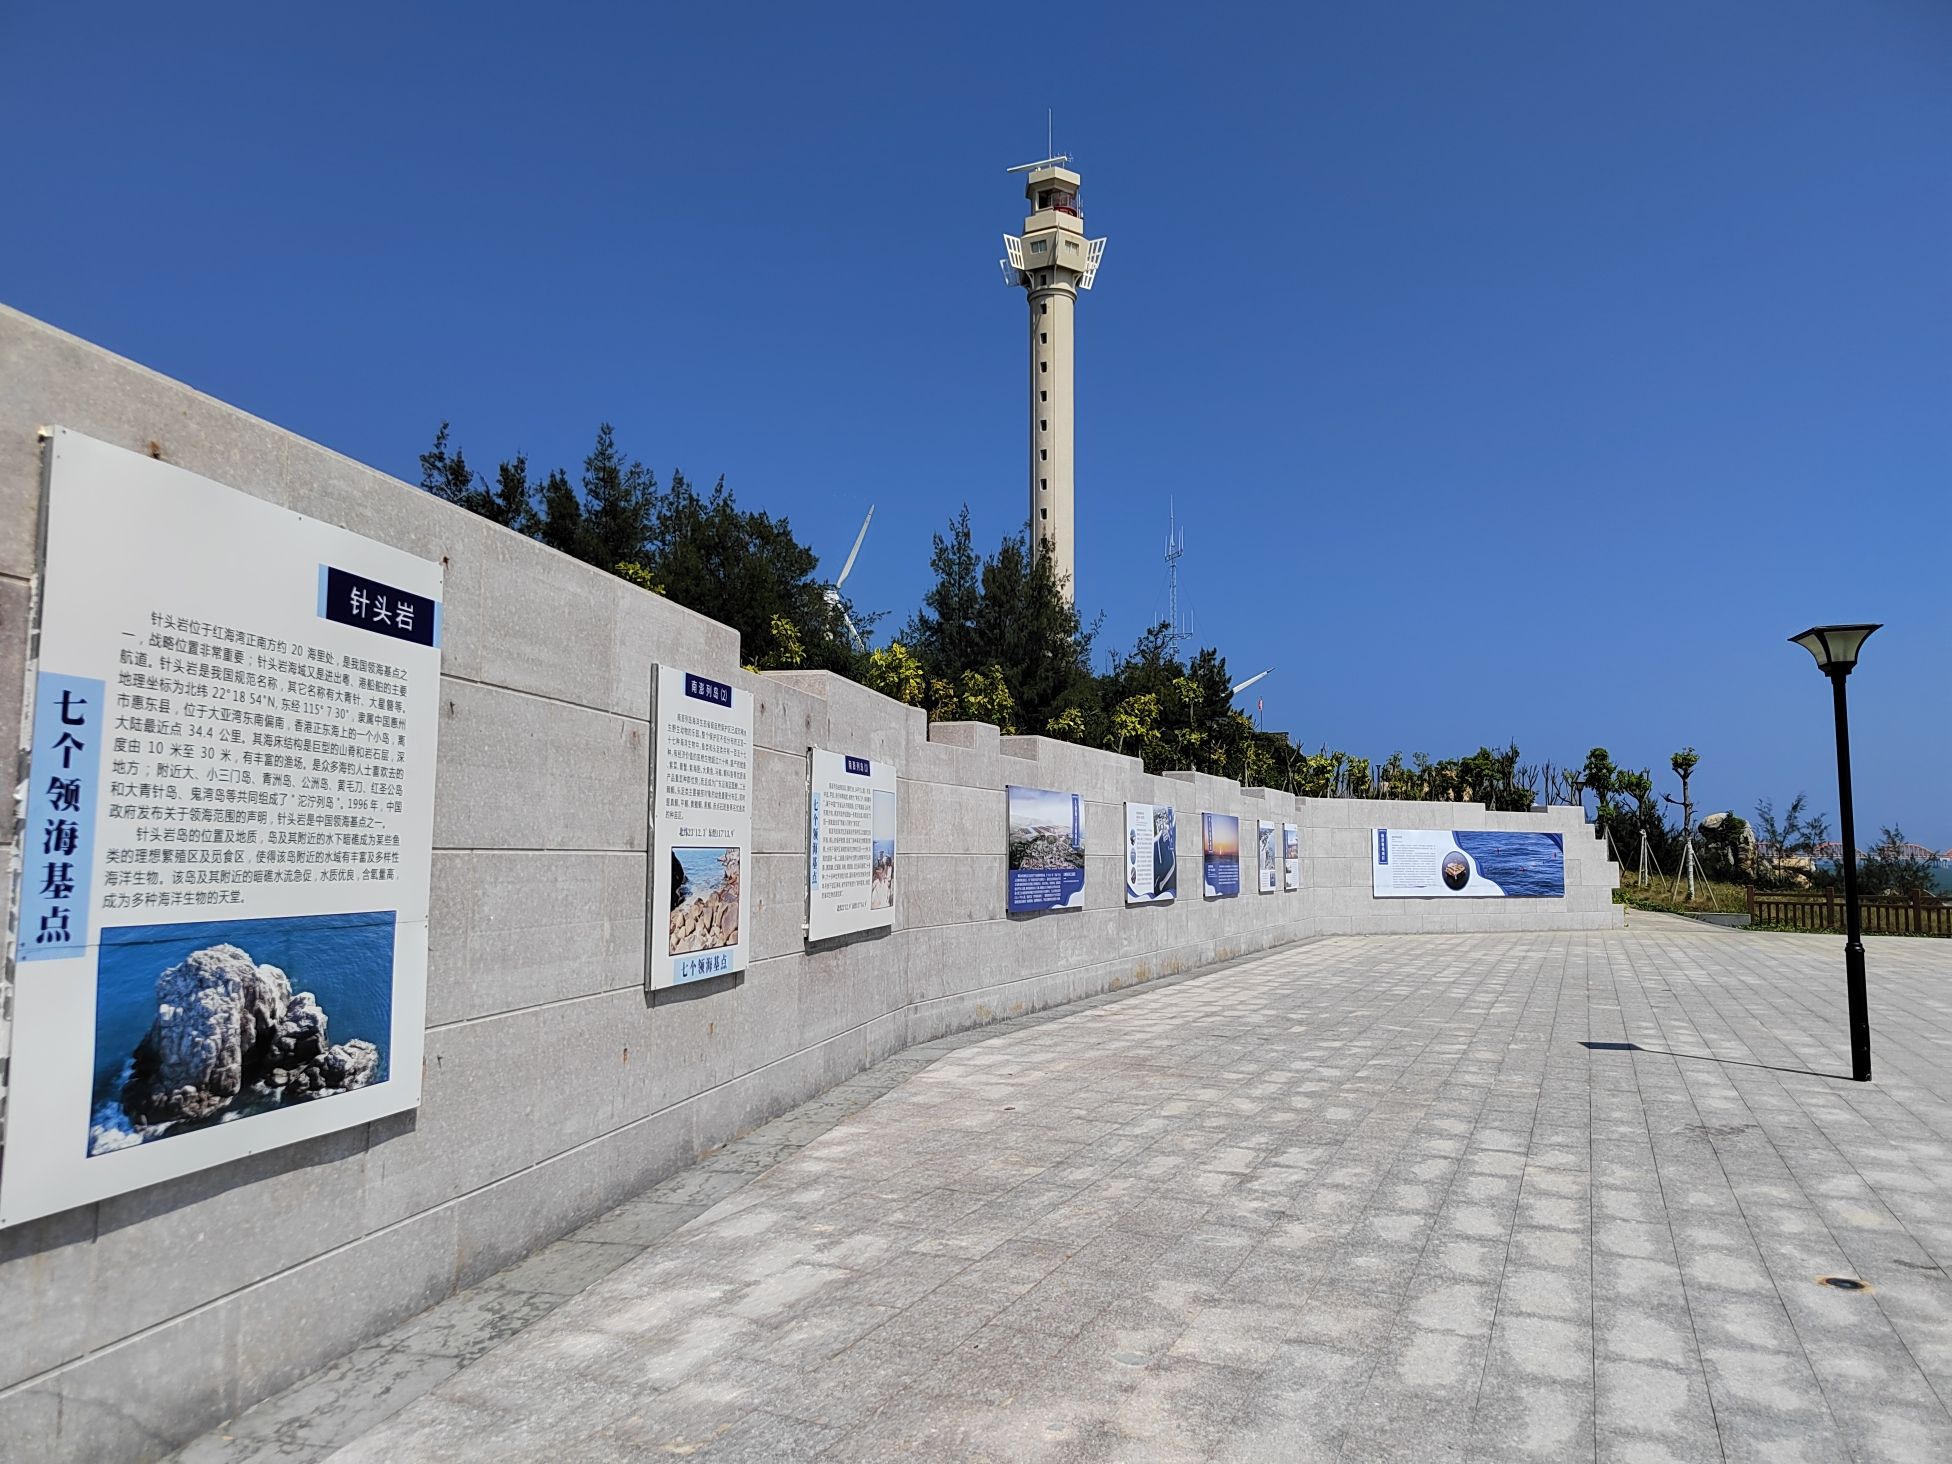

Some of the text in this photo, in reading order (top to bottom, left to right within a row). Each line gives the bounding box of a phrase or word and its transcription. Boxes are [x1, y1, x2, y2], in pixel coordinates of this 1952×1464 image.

[348, 585, 415, 632] 针头岩
[291, 643, 304, 658] 20
[114, 715, 183, 737] 大陆最近点
[188, 723, 214, 739] 34.4
[113, 737, 142, 754] 度由
[147, 740, 164, 755] 10
[170, 743, 194, 759] 米至
[200, 746, 215, 760] 30
[35, 688, 88, 945] 七个领海基点
[680, 955, 729, 979] 七个领海基点
